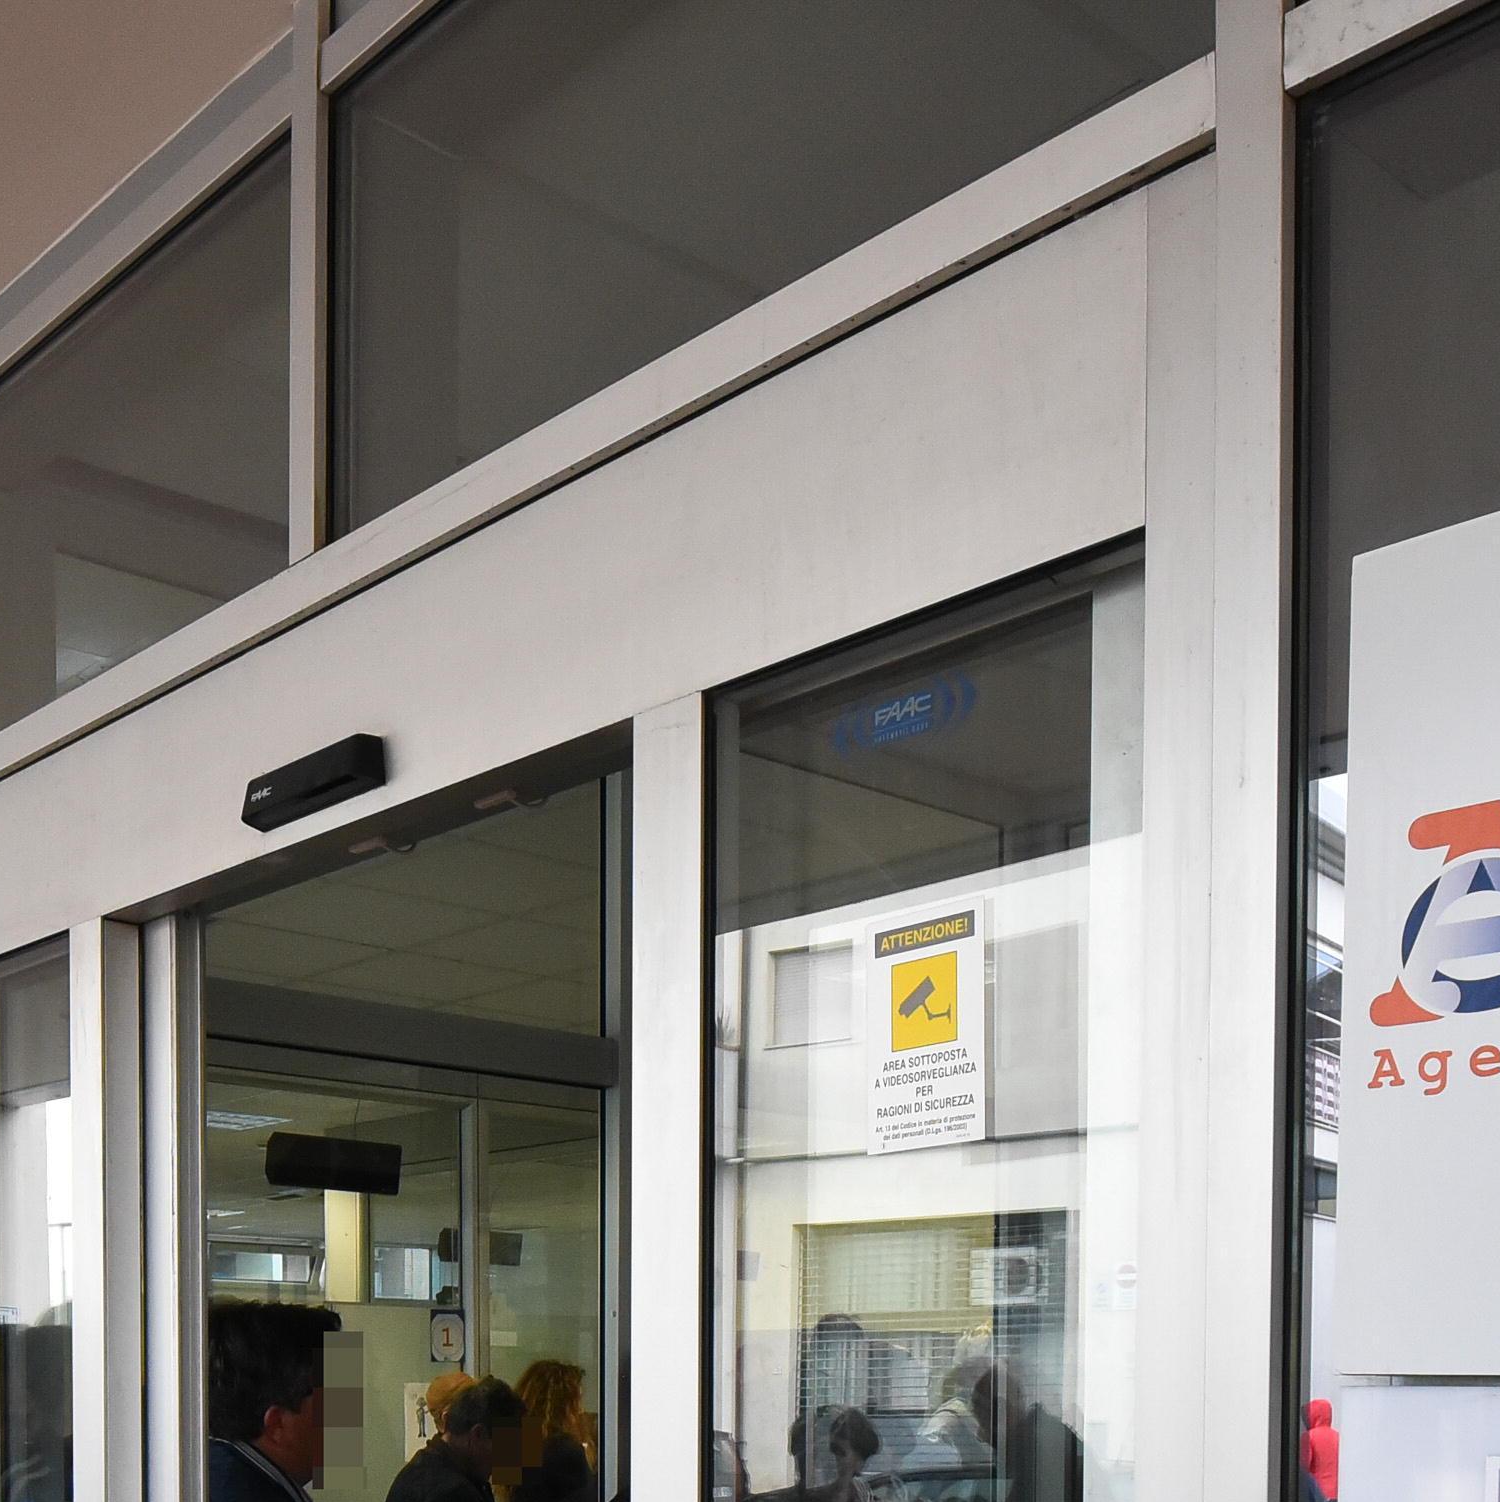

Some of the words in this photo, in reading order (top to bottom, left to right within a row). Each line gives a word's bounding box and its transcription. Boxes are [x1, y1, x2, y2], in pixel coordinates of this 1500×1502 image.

[875, 694, 932, 726] FAAC
[880, 917, 969, 952] ATTENZIONE!
[883, 1058, 906, 1073] AREA
[908, 1048, 968, 1068] SOTTOPOSTA
[874, 1078, 881, 1089] A
[882, 1062, 977, 1088] VIDEOSORVEGLIANZA
[915, 1084, 933, 1097] PER
[876, 1103, 912, 1119] RAGIONI
[914, 1102, 923, 1113] DI
[924, 1093, 975, 1111] SICUREZZA
[442, 1327, 453, 1347] 1
